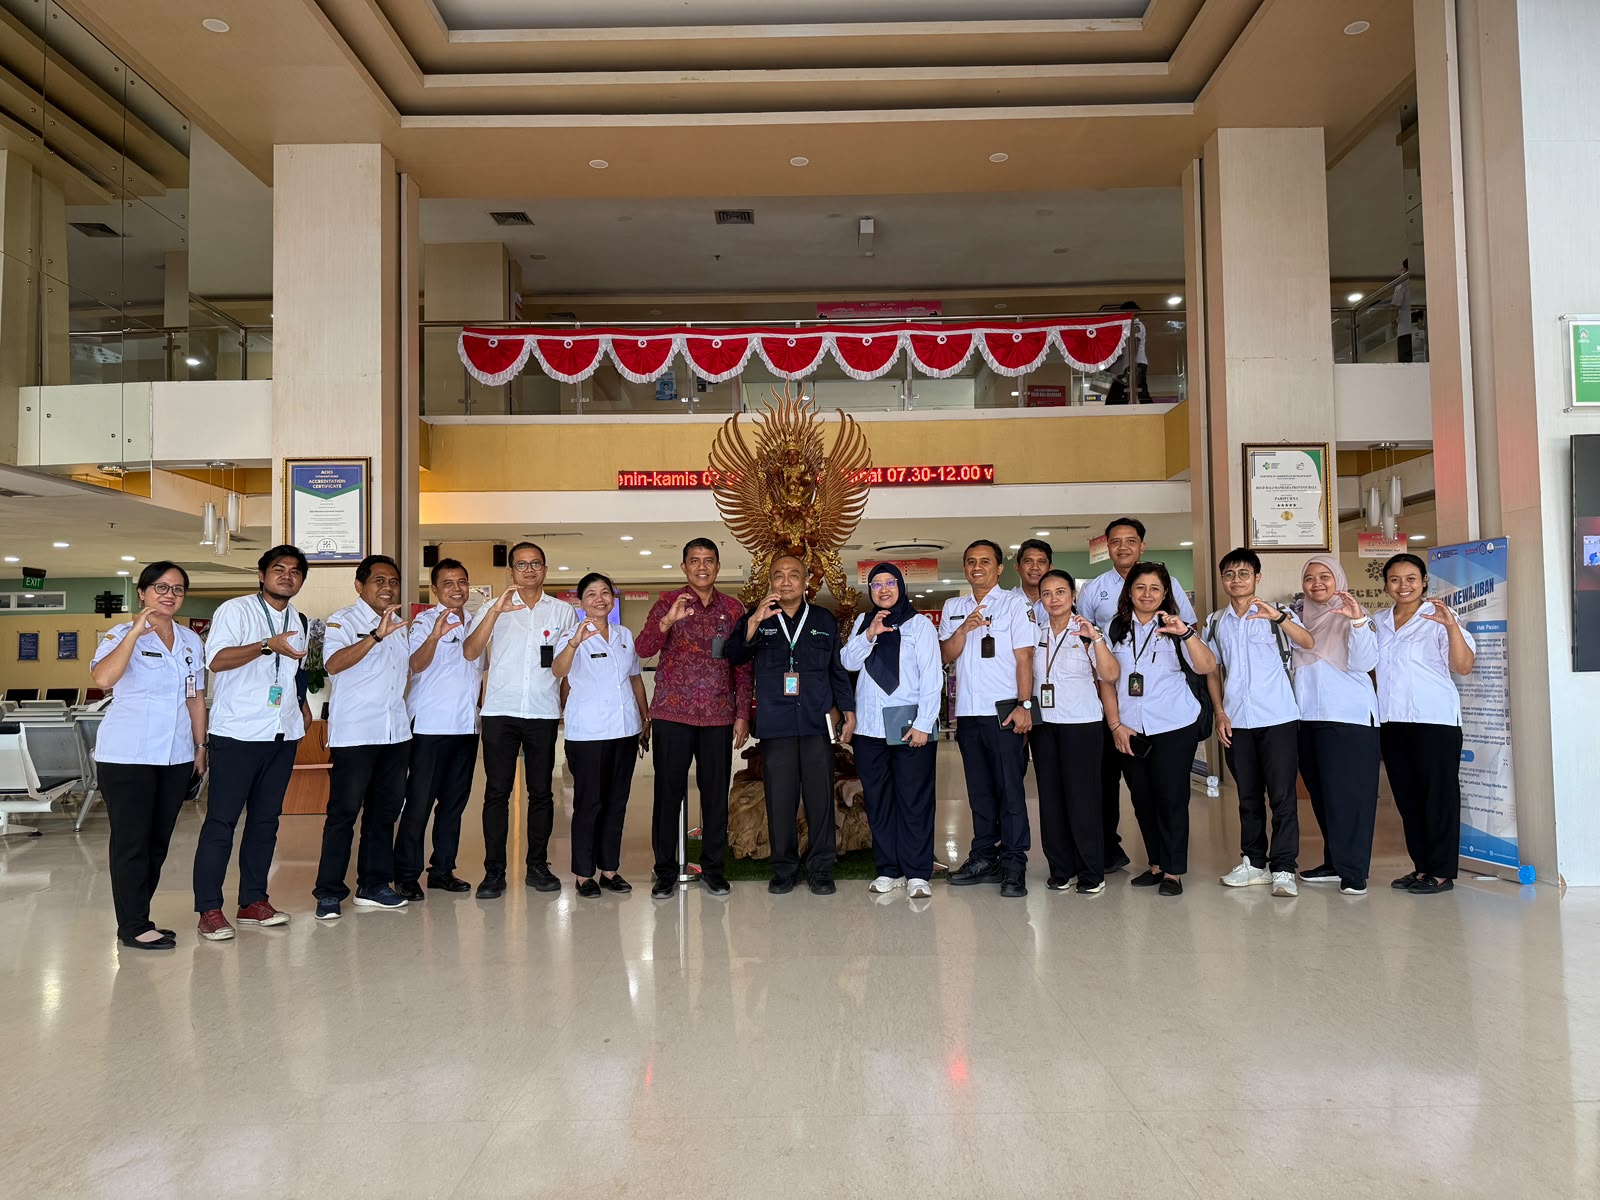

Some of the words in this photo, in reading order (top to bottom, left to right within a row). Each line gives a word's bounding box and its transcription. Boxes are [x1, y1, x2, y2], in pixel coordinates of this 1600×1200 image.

[887, 466, 980, 482] 07.30-12.00
[26, 577, 41, 587] EXIT
[1453, 577, 1494, 606] KEWAJIBAN
[1467, 598, 1487, 612] KELUARGA
